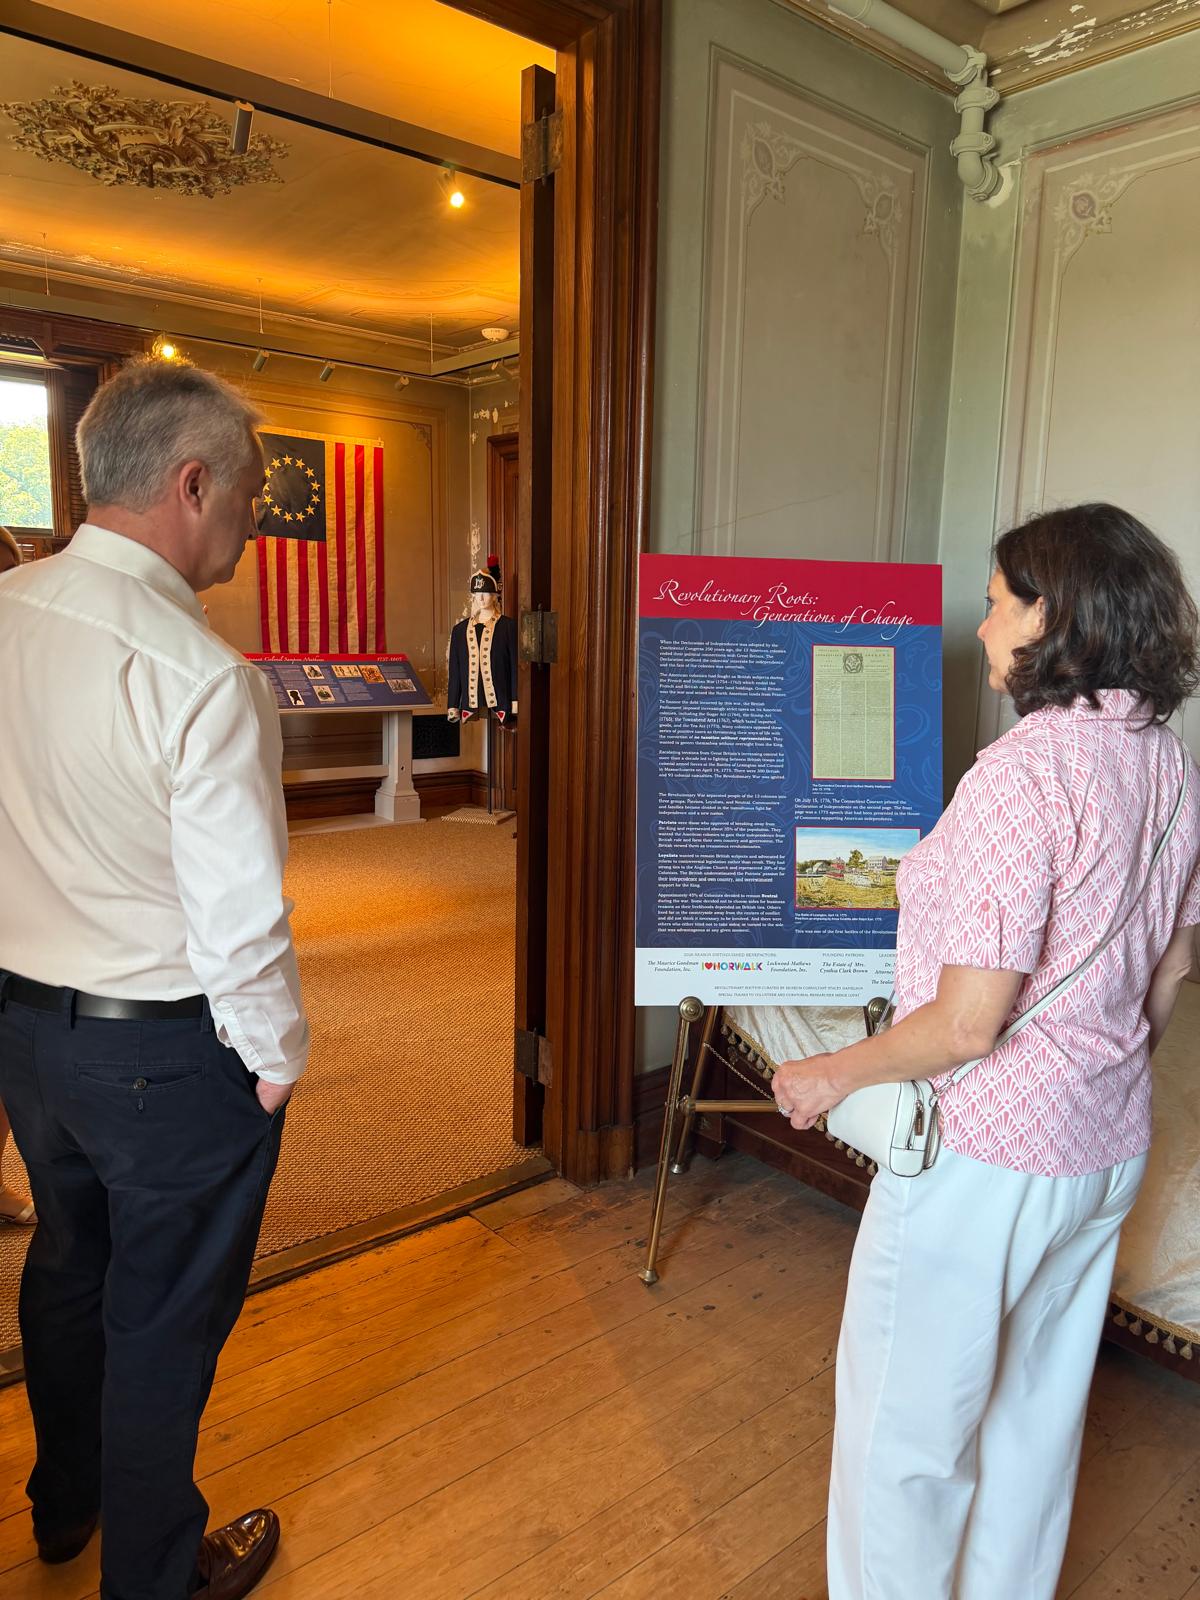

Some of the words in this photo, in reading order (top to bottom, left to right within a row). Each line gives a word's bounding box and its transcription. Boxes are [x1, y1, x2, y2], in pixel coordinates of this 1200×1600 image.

[653, 579, 762, 616] Revolutionary
[767, 582, 819, 608] Roots:
[752, 606, 836, 628] Generations
[835, 606, 862, 633] of
[860, 600, 914, 640] Change
[713, 962, 763, 970] NORWALK
